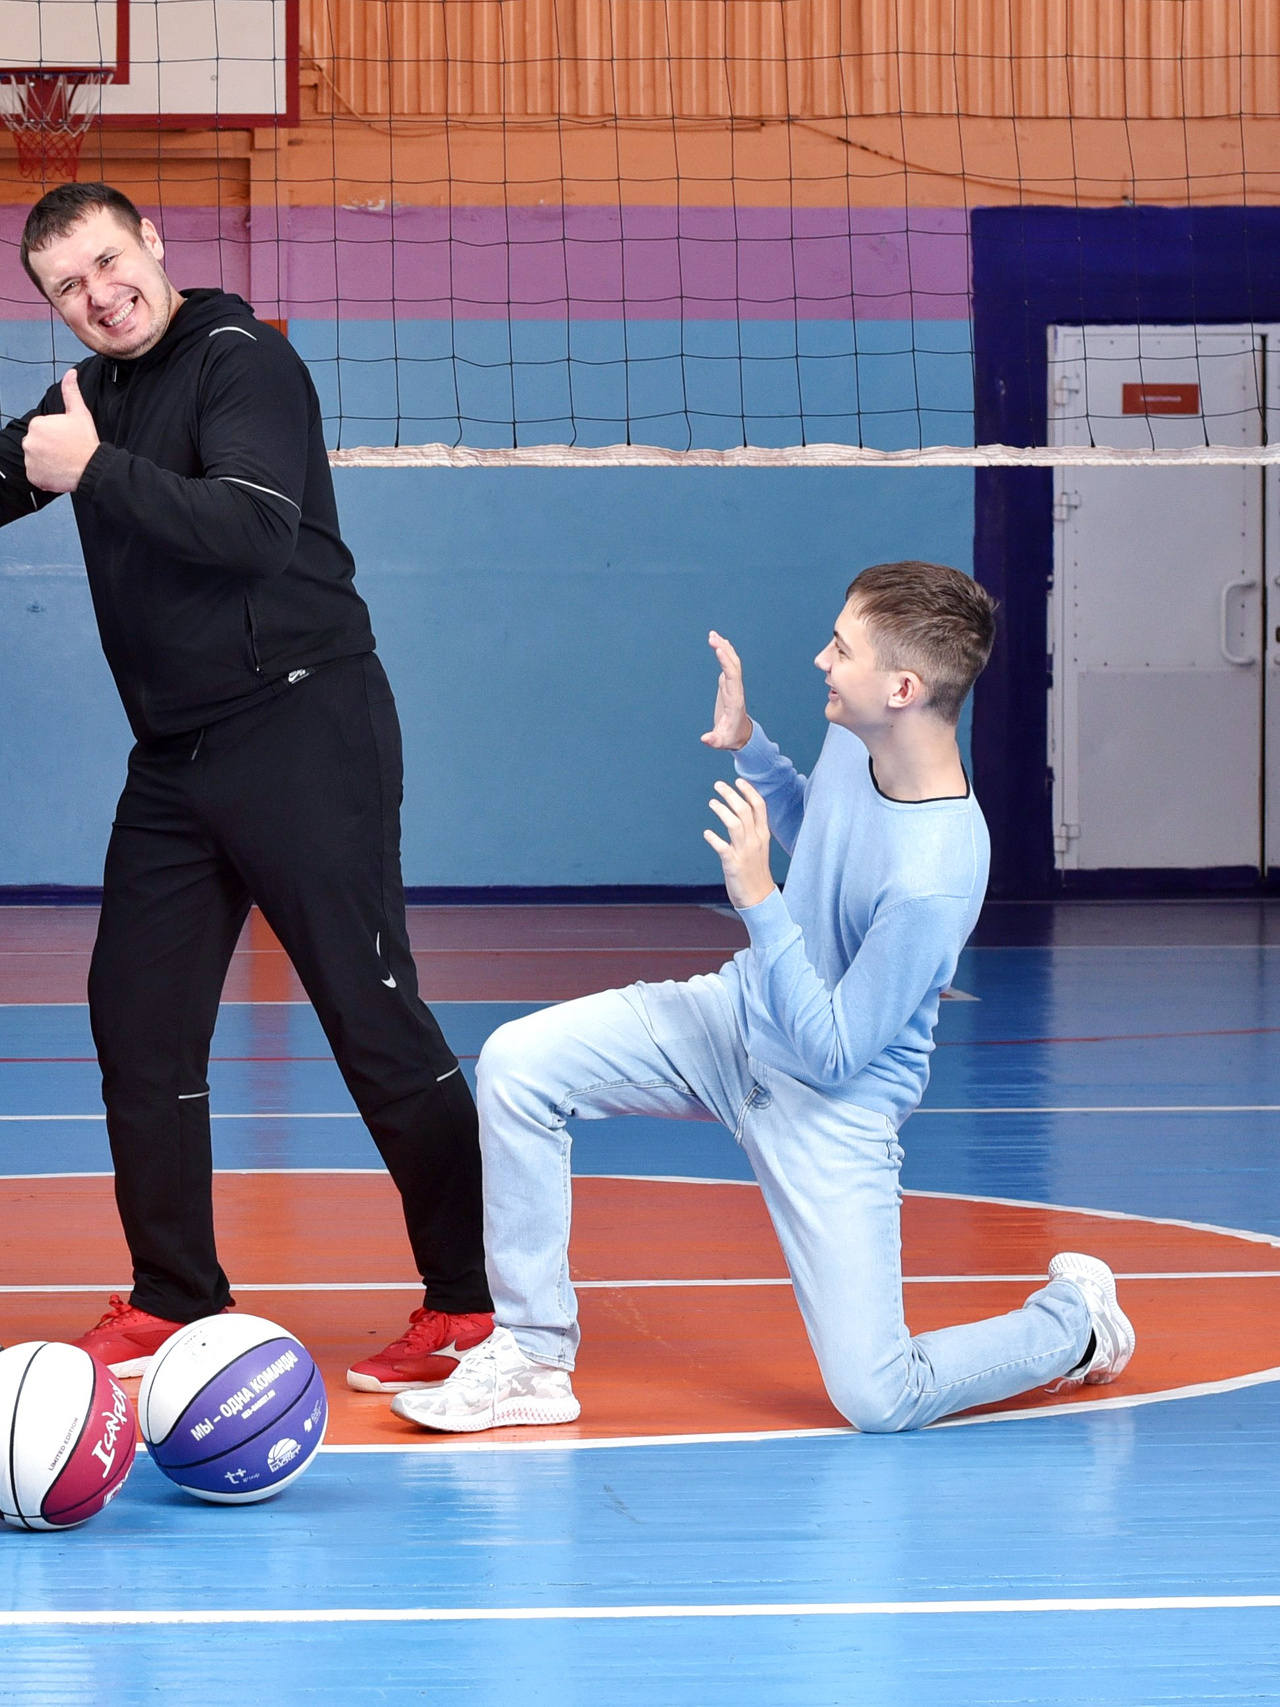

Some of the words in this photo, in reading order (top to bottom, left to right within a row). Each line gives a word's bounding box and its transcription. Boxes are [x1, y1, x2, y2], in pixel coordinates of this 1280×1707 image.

[191, 1418, 214, 1441] МЫ
[220, 1387, 255, 1417] ОДНА
[250, 1350, 299, 1393] КОМАНДА!
[48, 1445, 66, 1471] LIMITED
[63, 1417, 78, 1445] EDITION
